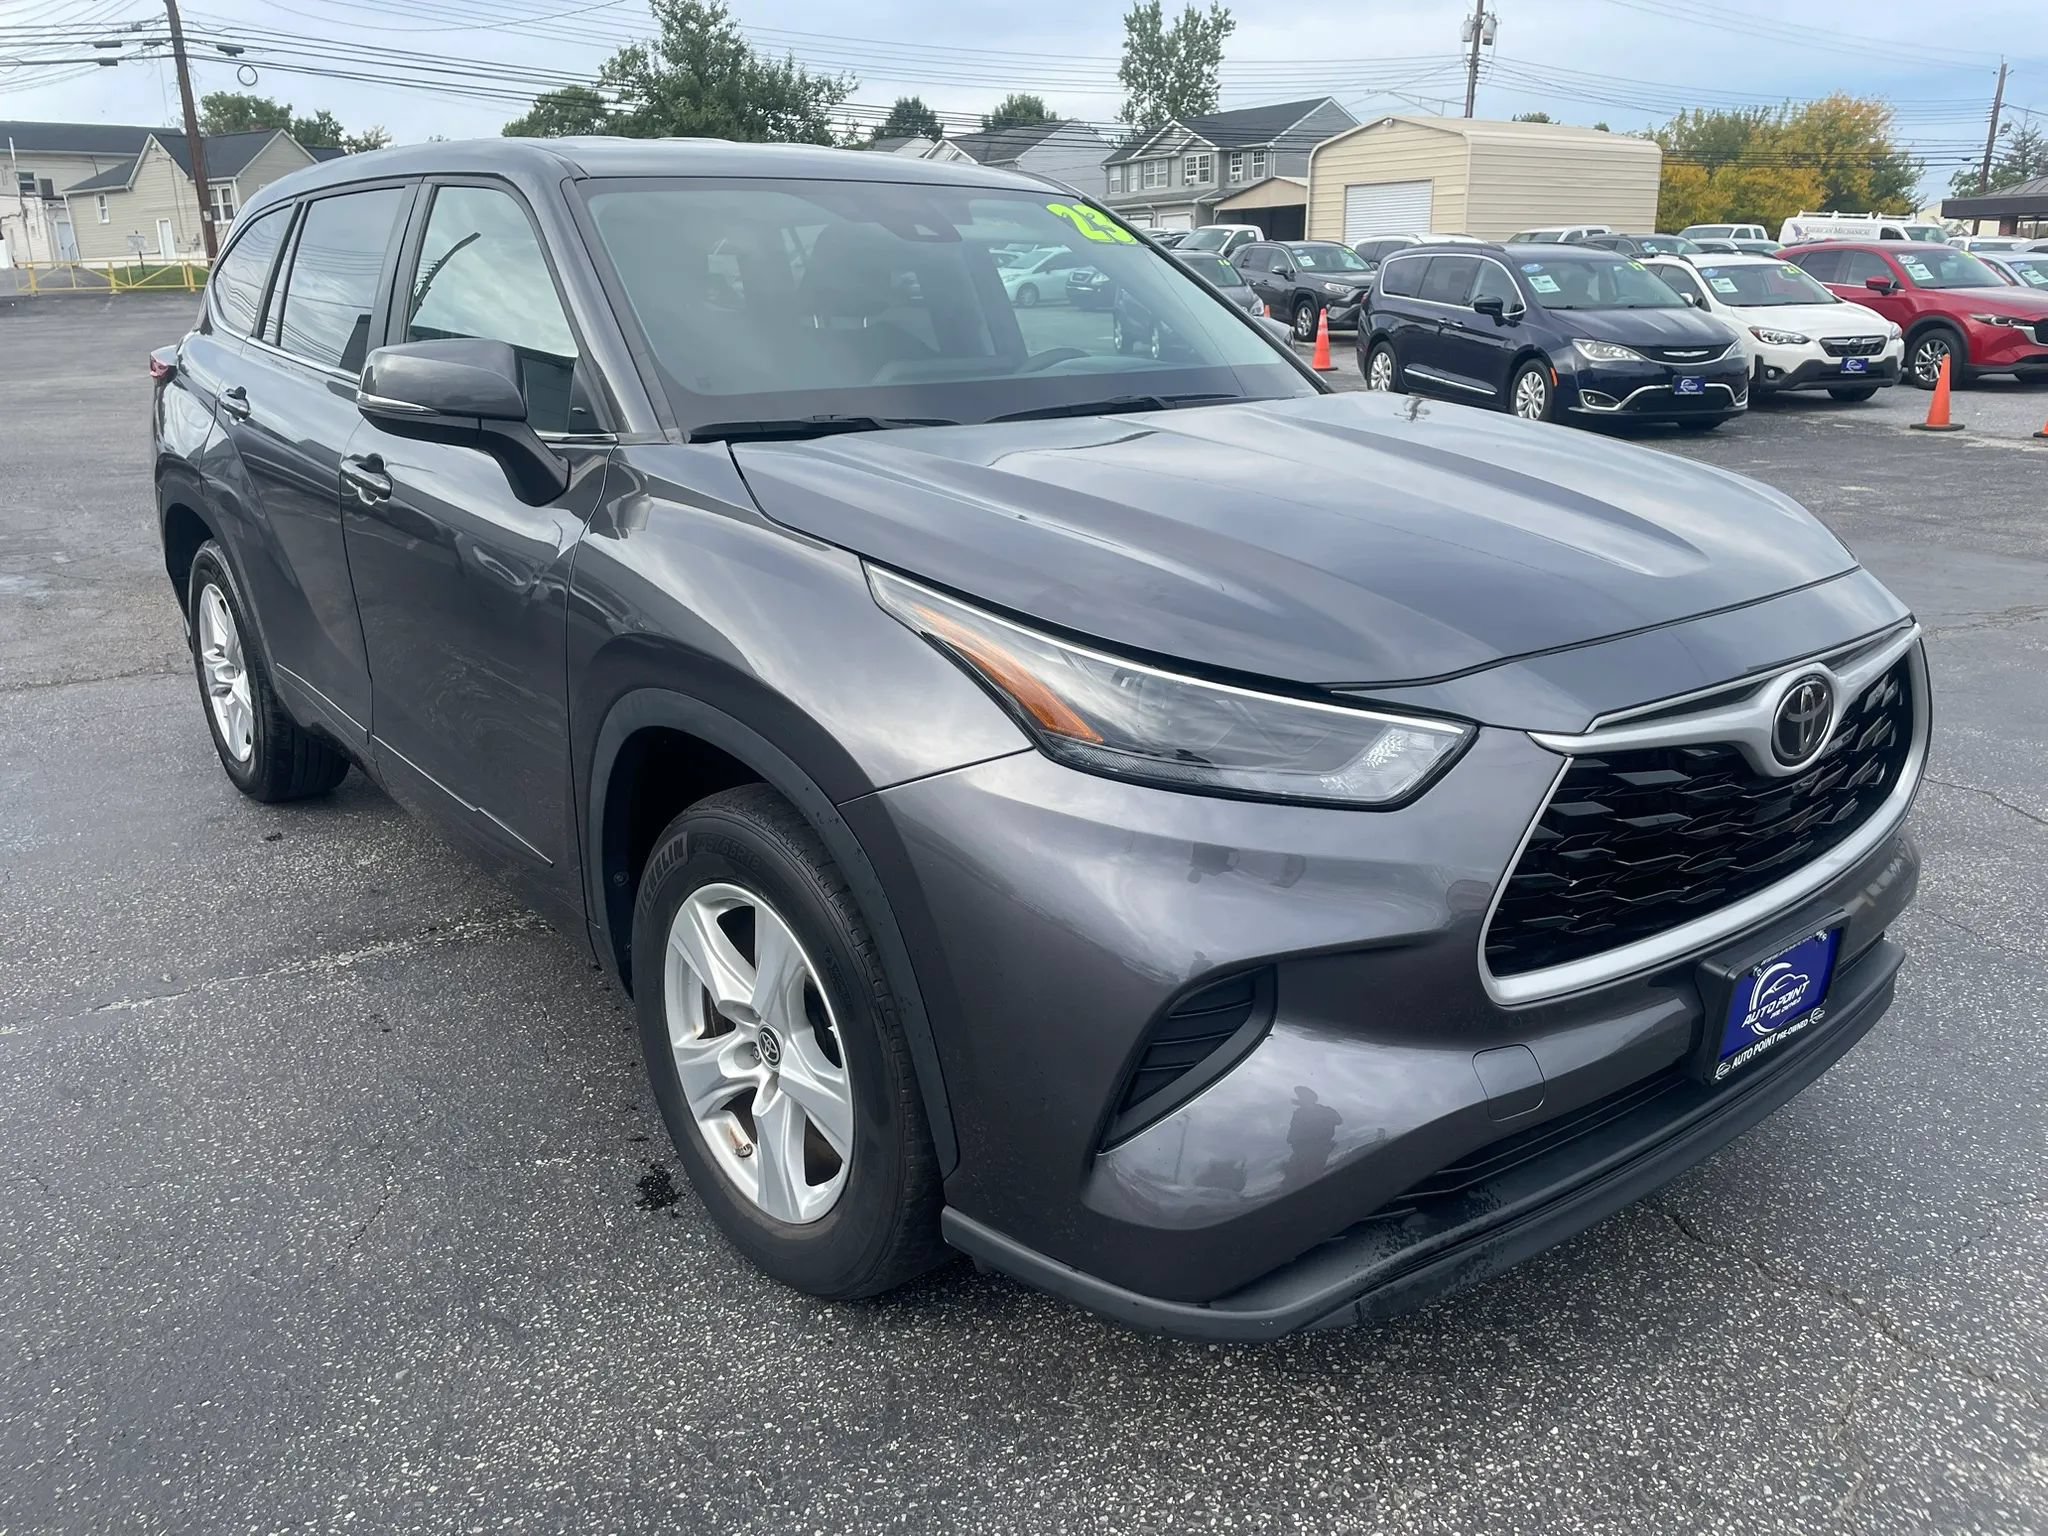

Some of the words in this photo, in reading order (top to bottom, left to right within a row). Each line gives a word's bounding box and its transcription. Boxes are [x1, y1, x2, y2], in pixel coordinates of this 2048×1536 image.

[1046, 203, 1137, 244] 23
[1741, 1000, 1778, 1028] AUTO
[1776, 980, 1811, 1008] POINT
[1732, 1048, 1753, 1069] AUTO
[1753, 1033, 1778, 1056] POINT
